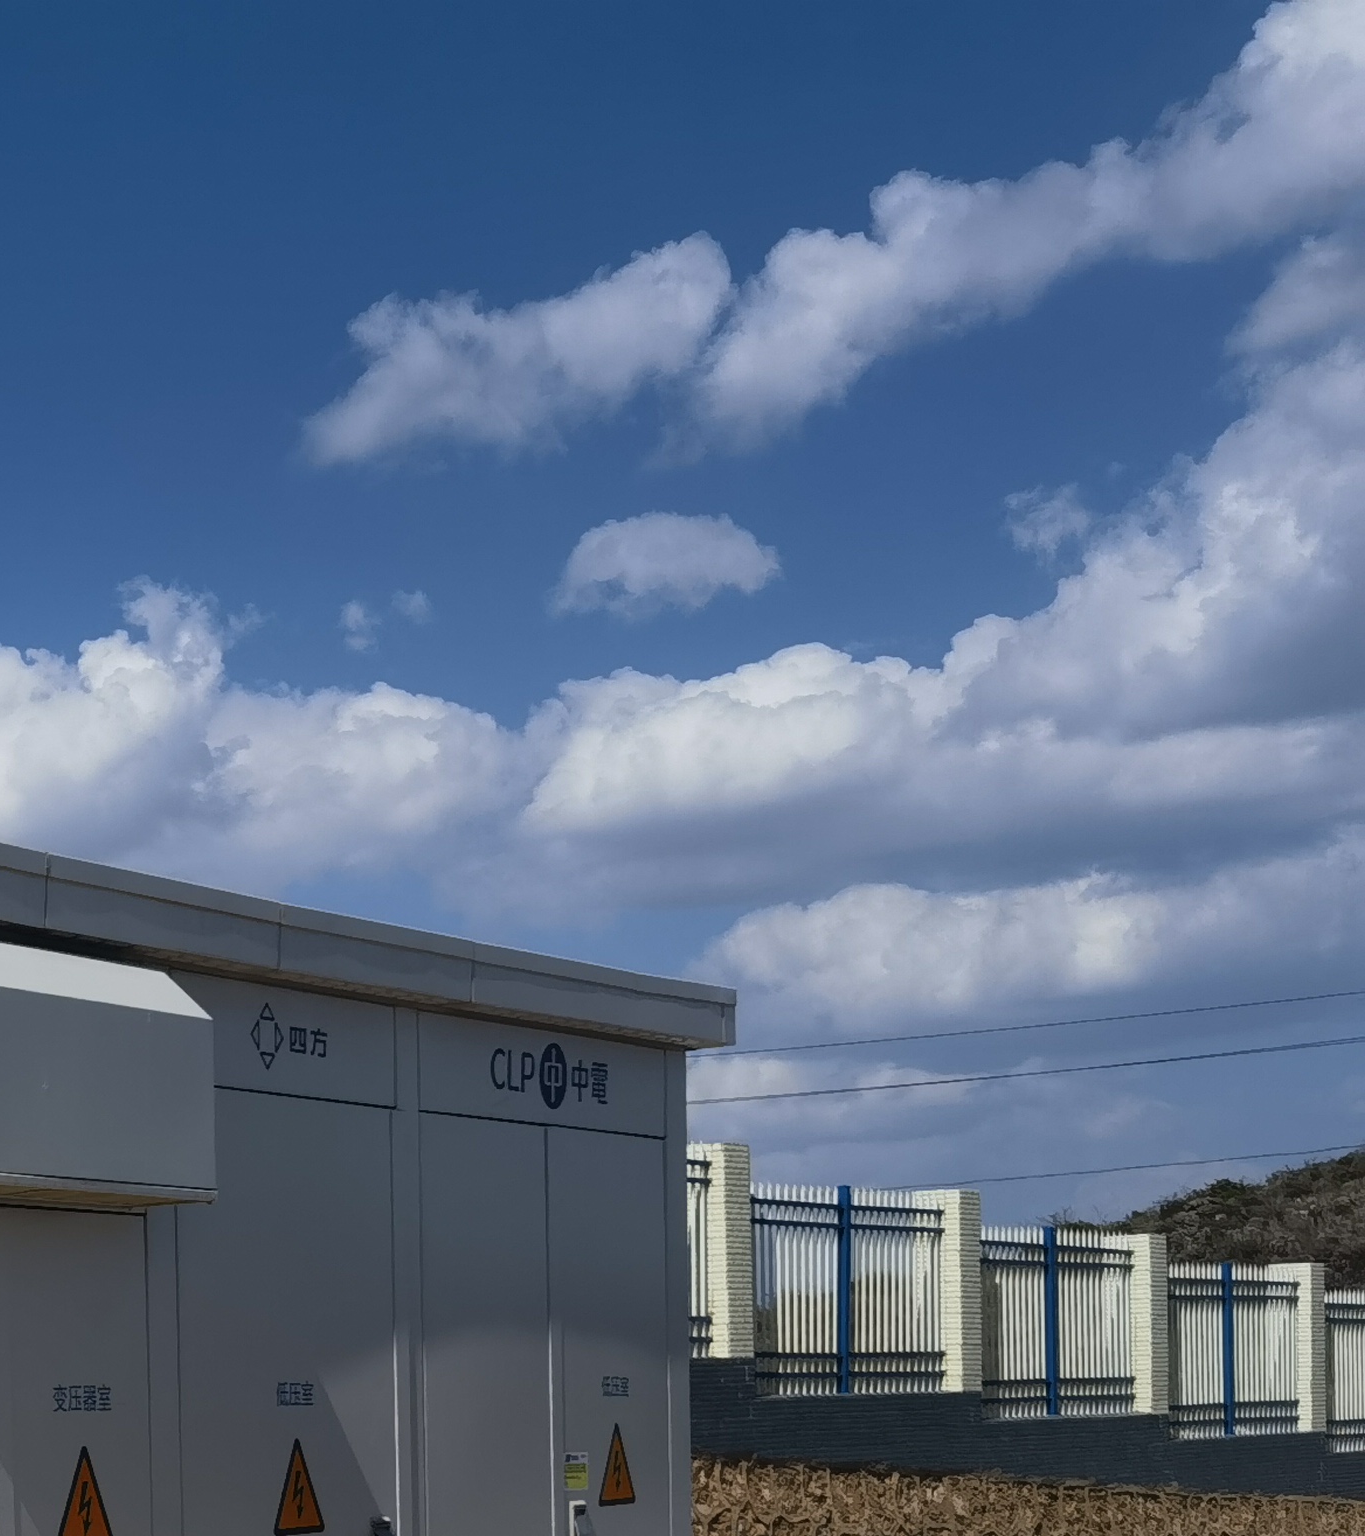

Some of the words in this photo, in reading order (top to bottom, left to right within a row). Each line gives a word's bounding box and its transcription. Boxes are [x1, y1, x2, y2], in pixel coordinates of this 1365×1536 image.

[289, 1026, 328, 1058] 四方
[490, 1048, 535, 1093] CLP
[571, 1059, 609, 1105] 中電
[52, 1384, 112, 1412] 变压器室
[276, 1380, 314, 1407] 低压室
